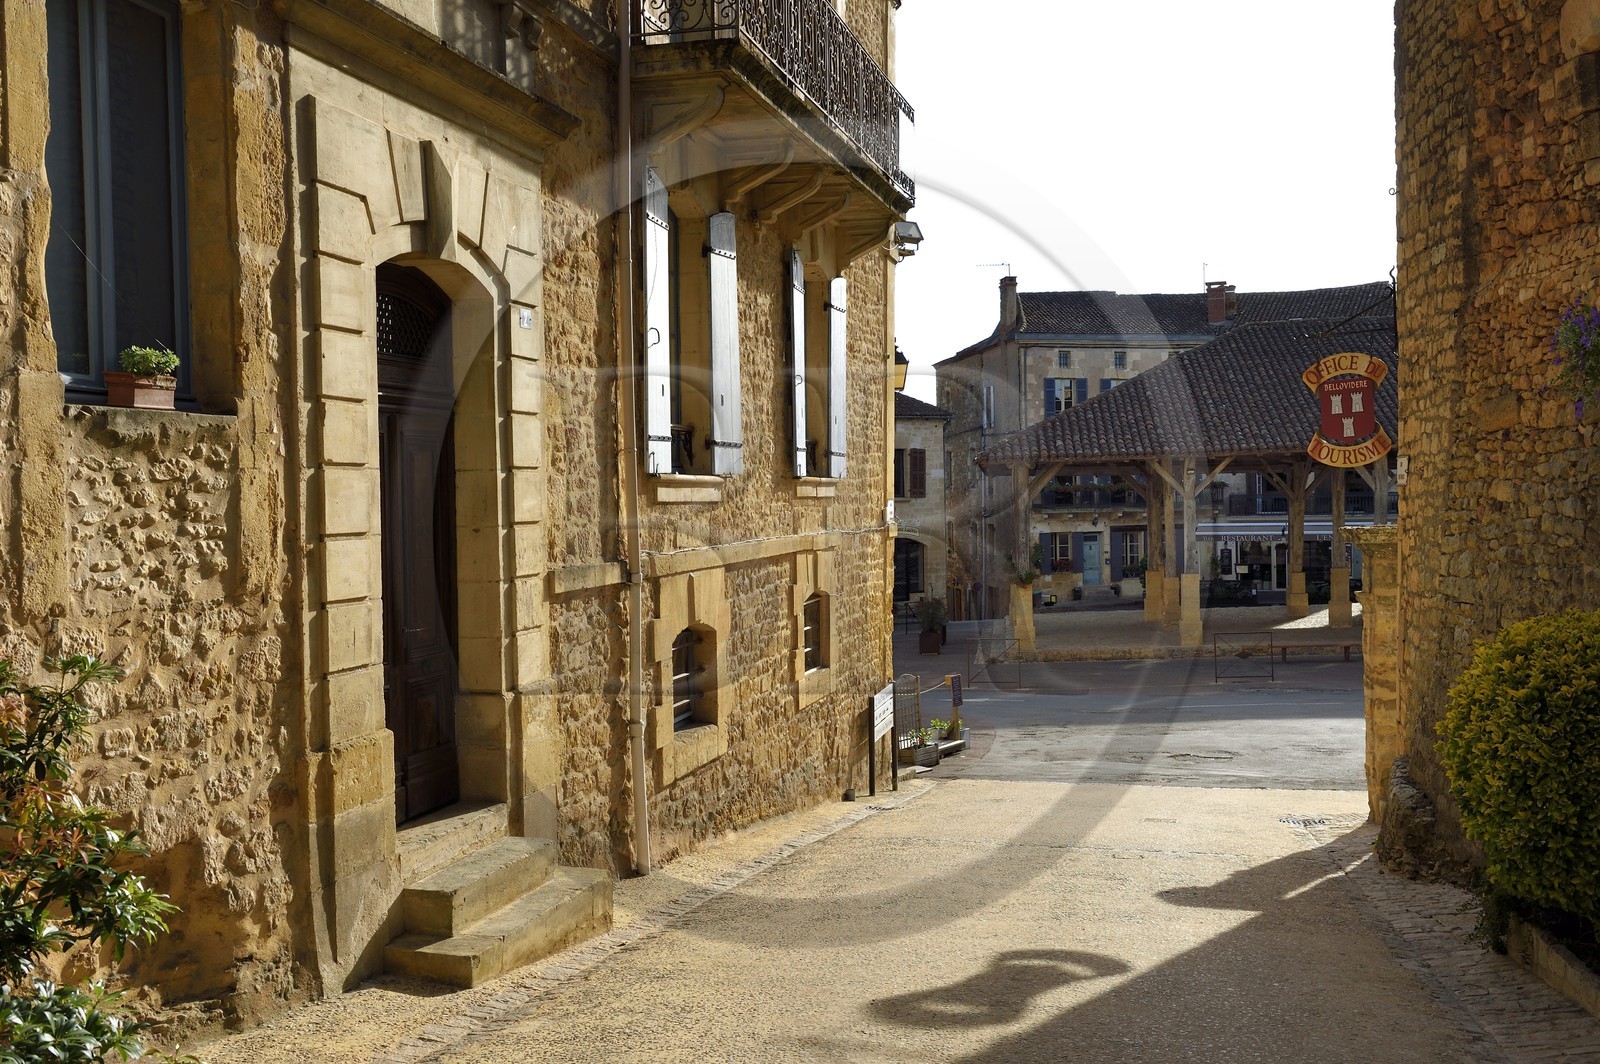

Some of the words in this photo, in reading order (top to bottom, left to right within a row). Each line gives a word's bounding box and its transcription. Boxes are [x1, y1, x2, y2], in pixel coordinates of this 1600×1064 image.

[1305, 355, 1359, 385] OFFICE
[1364, 359, 1387, 379] DU
[1324, 380, 1368, 392] BELLOVIDERE
[1309, 435, 1391, 465] TOURISME
[1221, 534, 1275, 542] RESTAURANT
